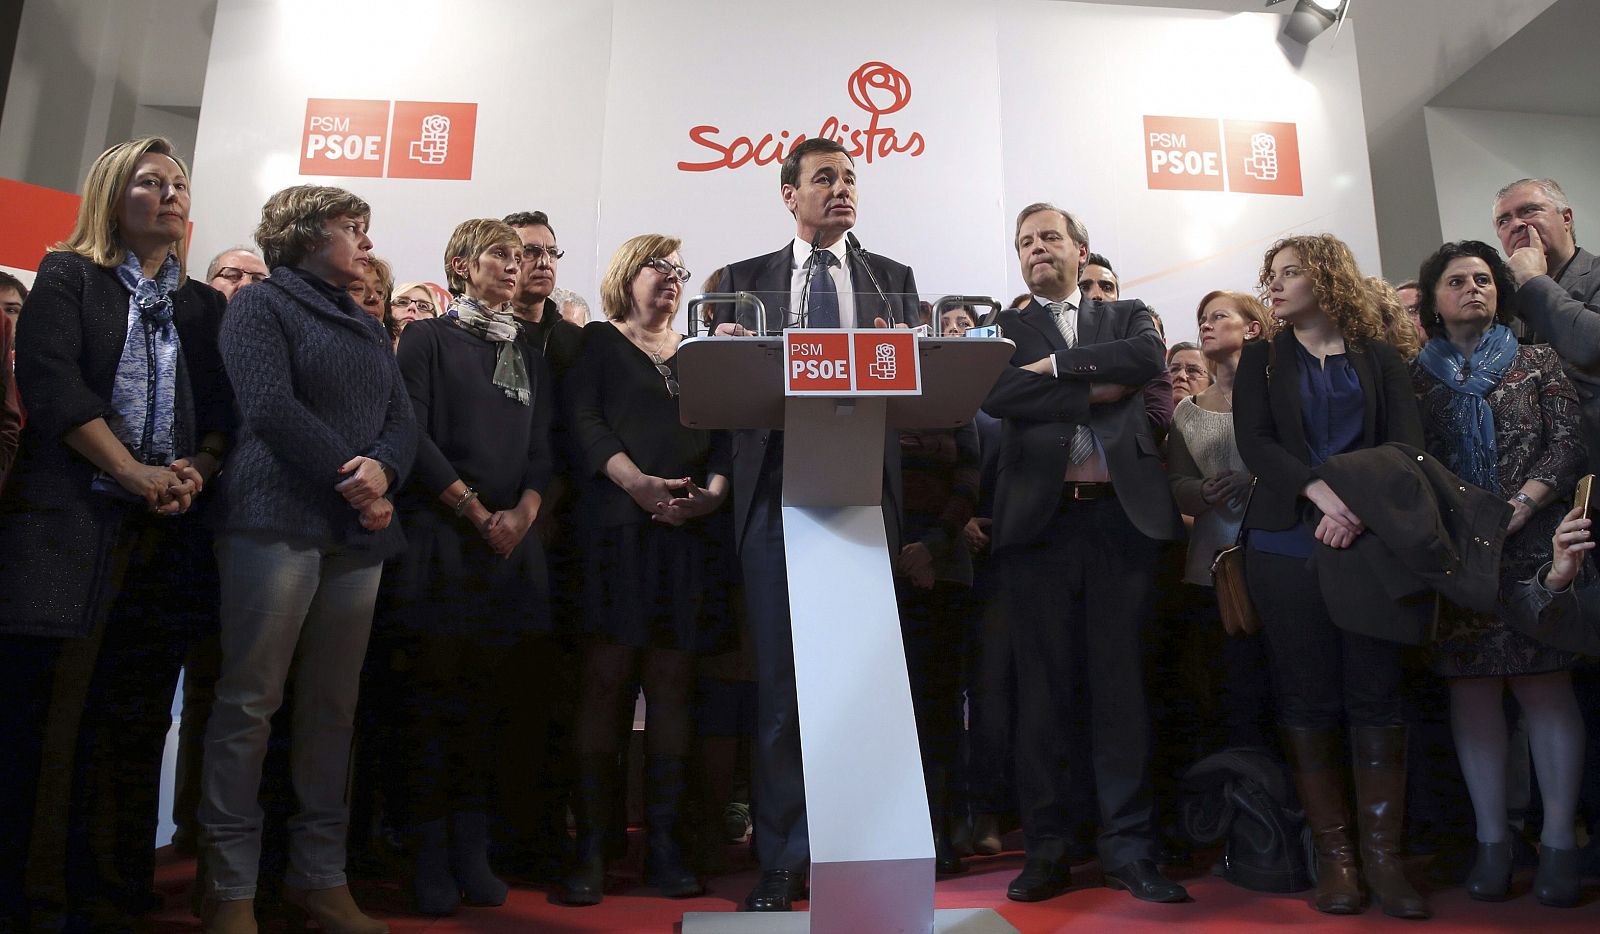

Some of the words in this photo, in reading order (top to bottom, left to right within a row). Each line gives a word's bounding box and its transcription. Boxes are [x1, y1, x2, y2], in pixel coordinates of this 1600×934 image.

[309, 116, 350, 132] PSM
[306, 134, 382, 160] PSOE
[1149, 132, 1187, 148] PSM
[1151, 150, 1220, 176] PSOE
[791, 343, 823, 356] PSM
[792, 359, 848, 379] PSOE
